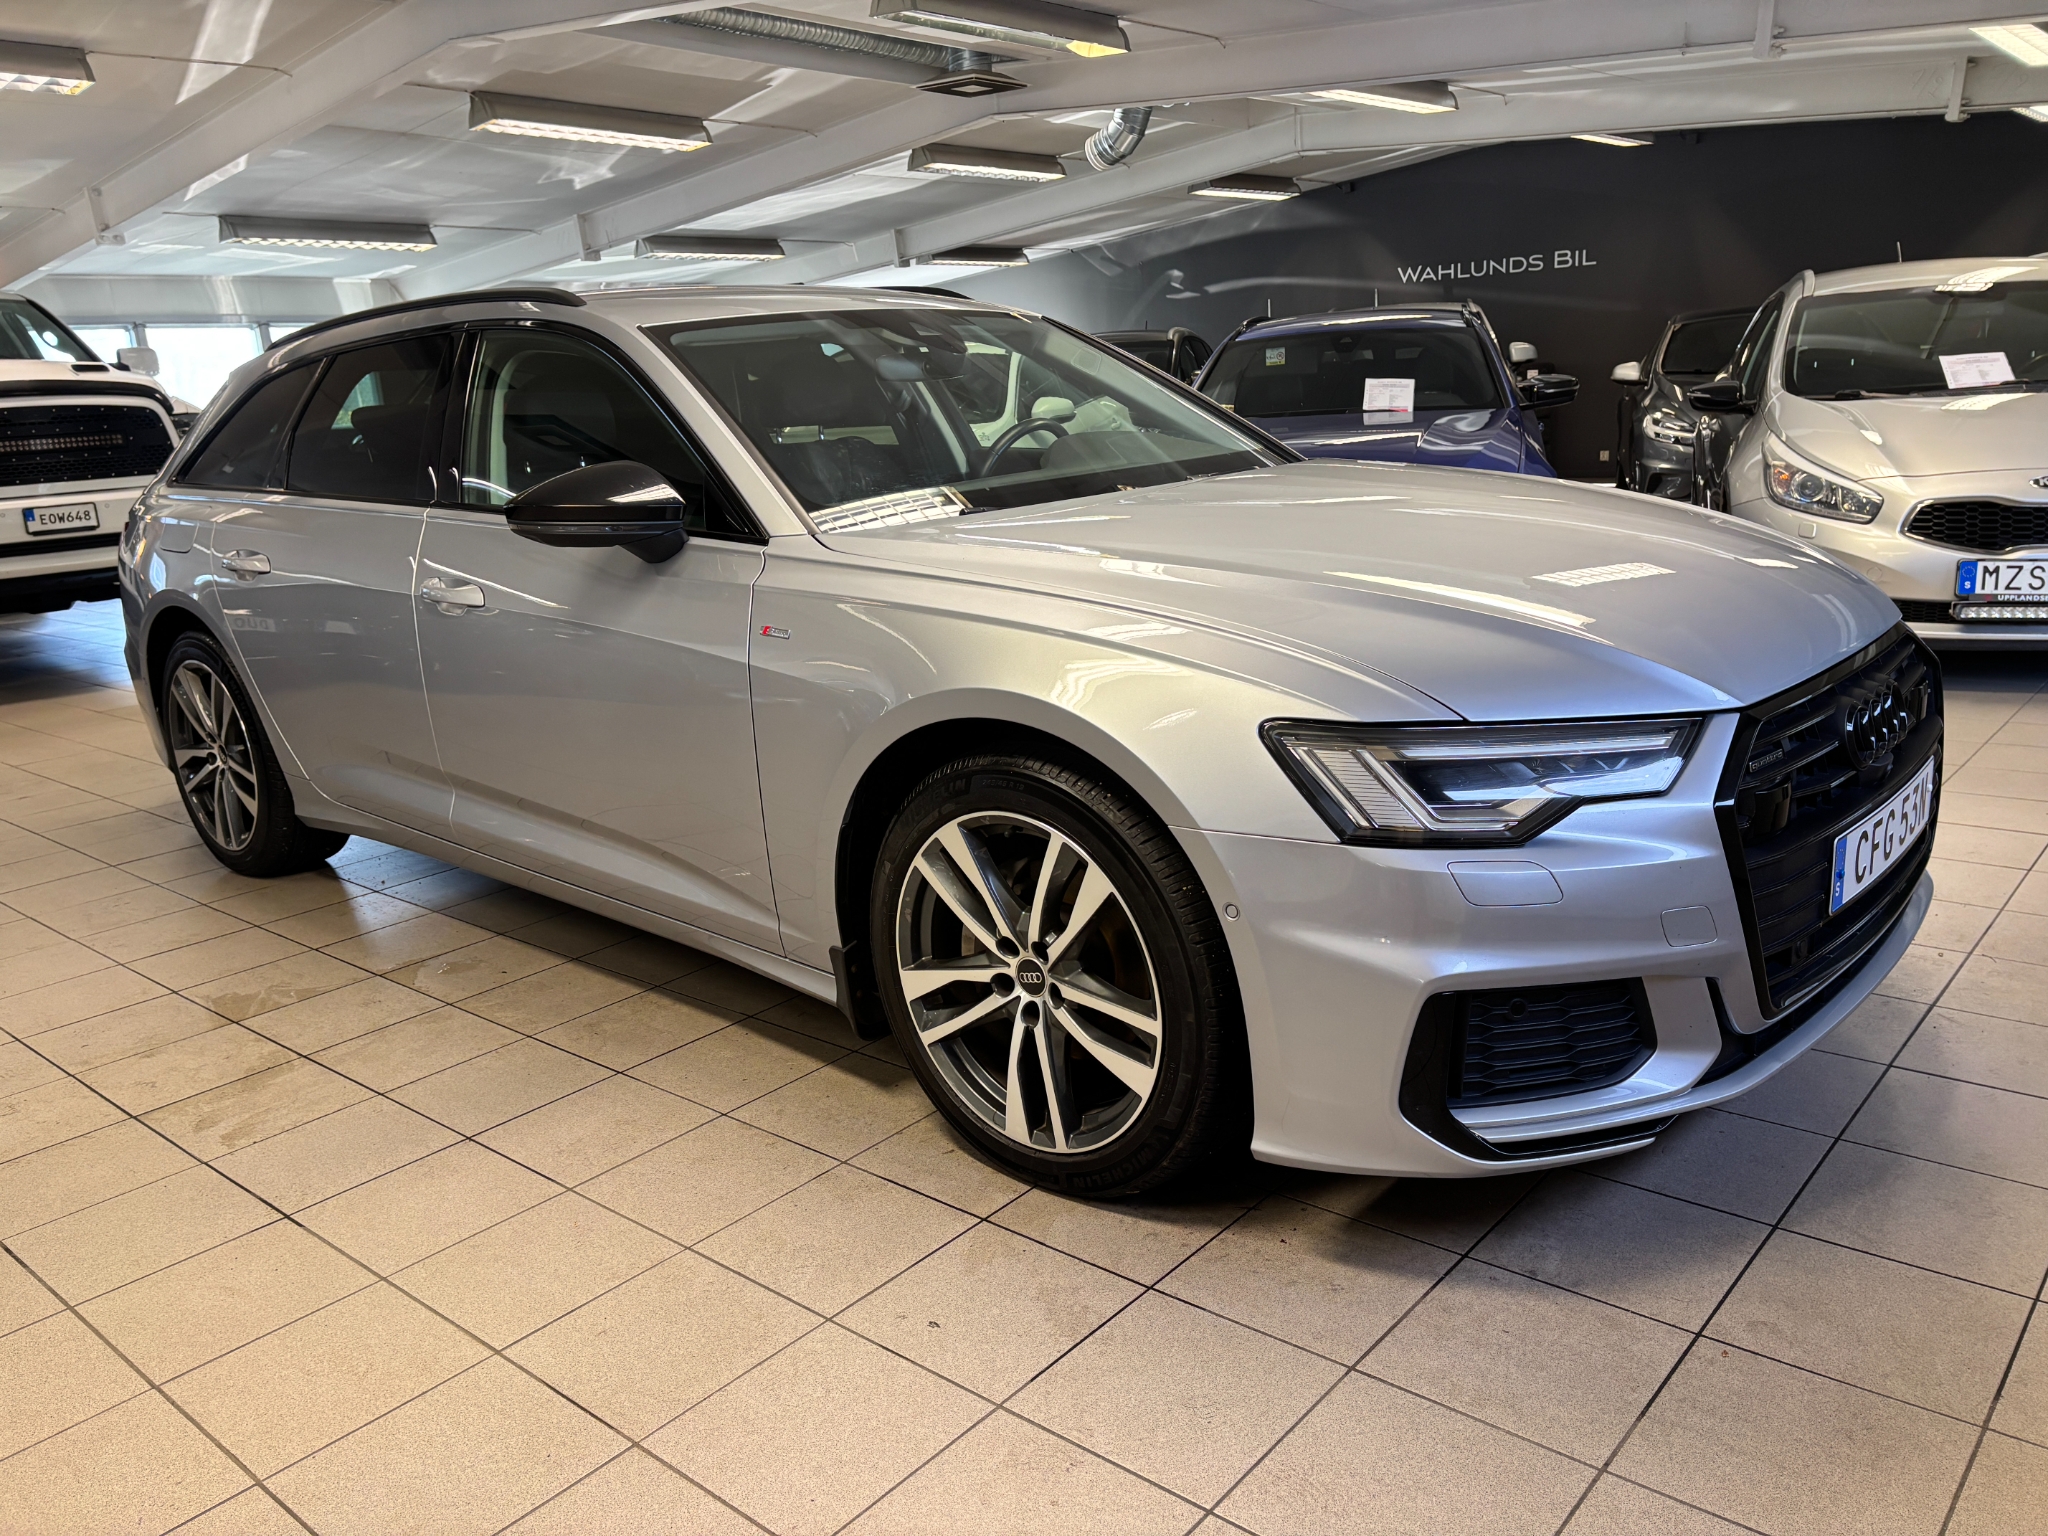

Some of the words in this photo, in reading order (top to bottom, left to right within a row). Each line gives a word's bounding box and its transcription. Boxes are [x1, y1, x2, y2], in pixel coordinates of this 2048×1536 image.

[1397, 254, 1544, 284] WAHLUNDS
[1553, 249, 1597, 269] BIL
[39, 510, 92, 525] EOW648
[1964, 581, 1971, 589] S
[1981, 565, 2046, 591] MZS
[1854, 808, 1895, 884] CFG
[1835, 882, 1841, 897] S
